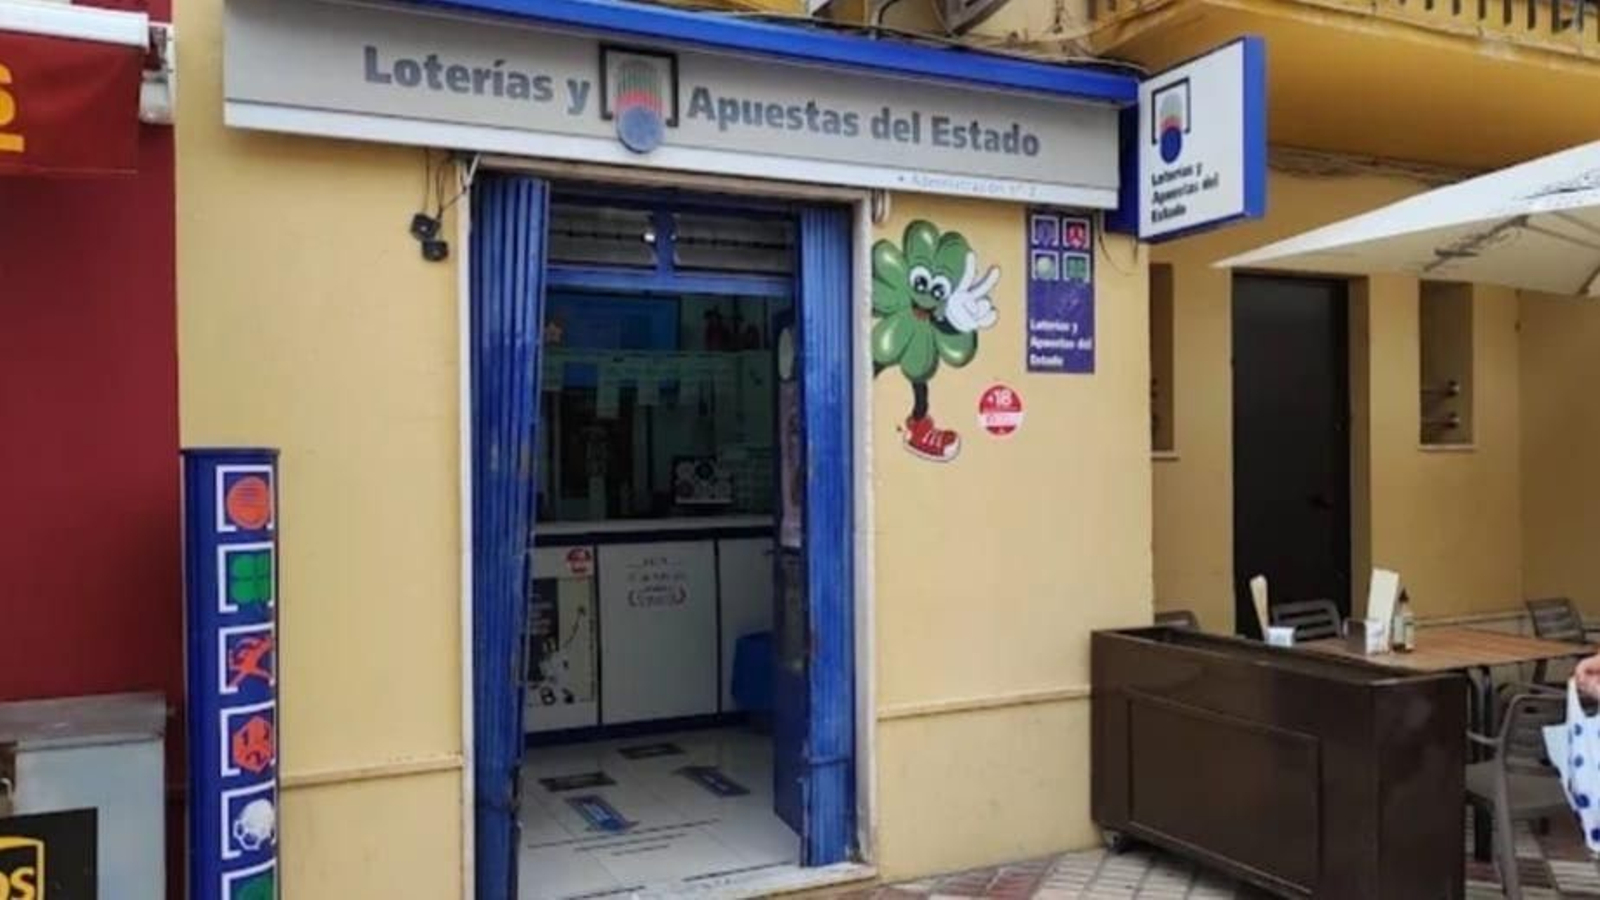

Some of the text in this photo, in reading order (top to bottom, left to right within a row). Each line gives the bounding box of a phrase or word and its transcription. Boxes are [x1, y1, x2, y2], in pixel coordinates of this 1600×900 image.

[364, 45, 591, 116] Loterías y
[687, 86, 1040, 157] Apuestas del Estado
